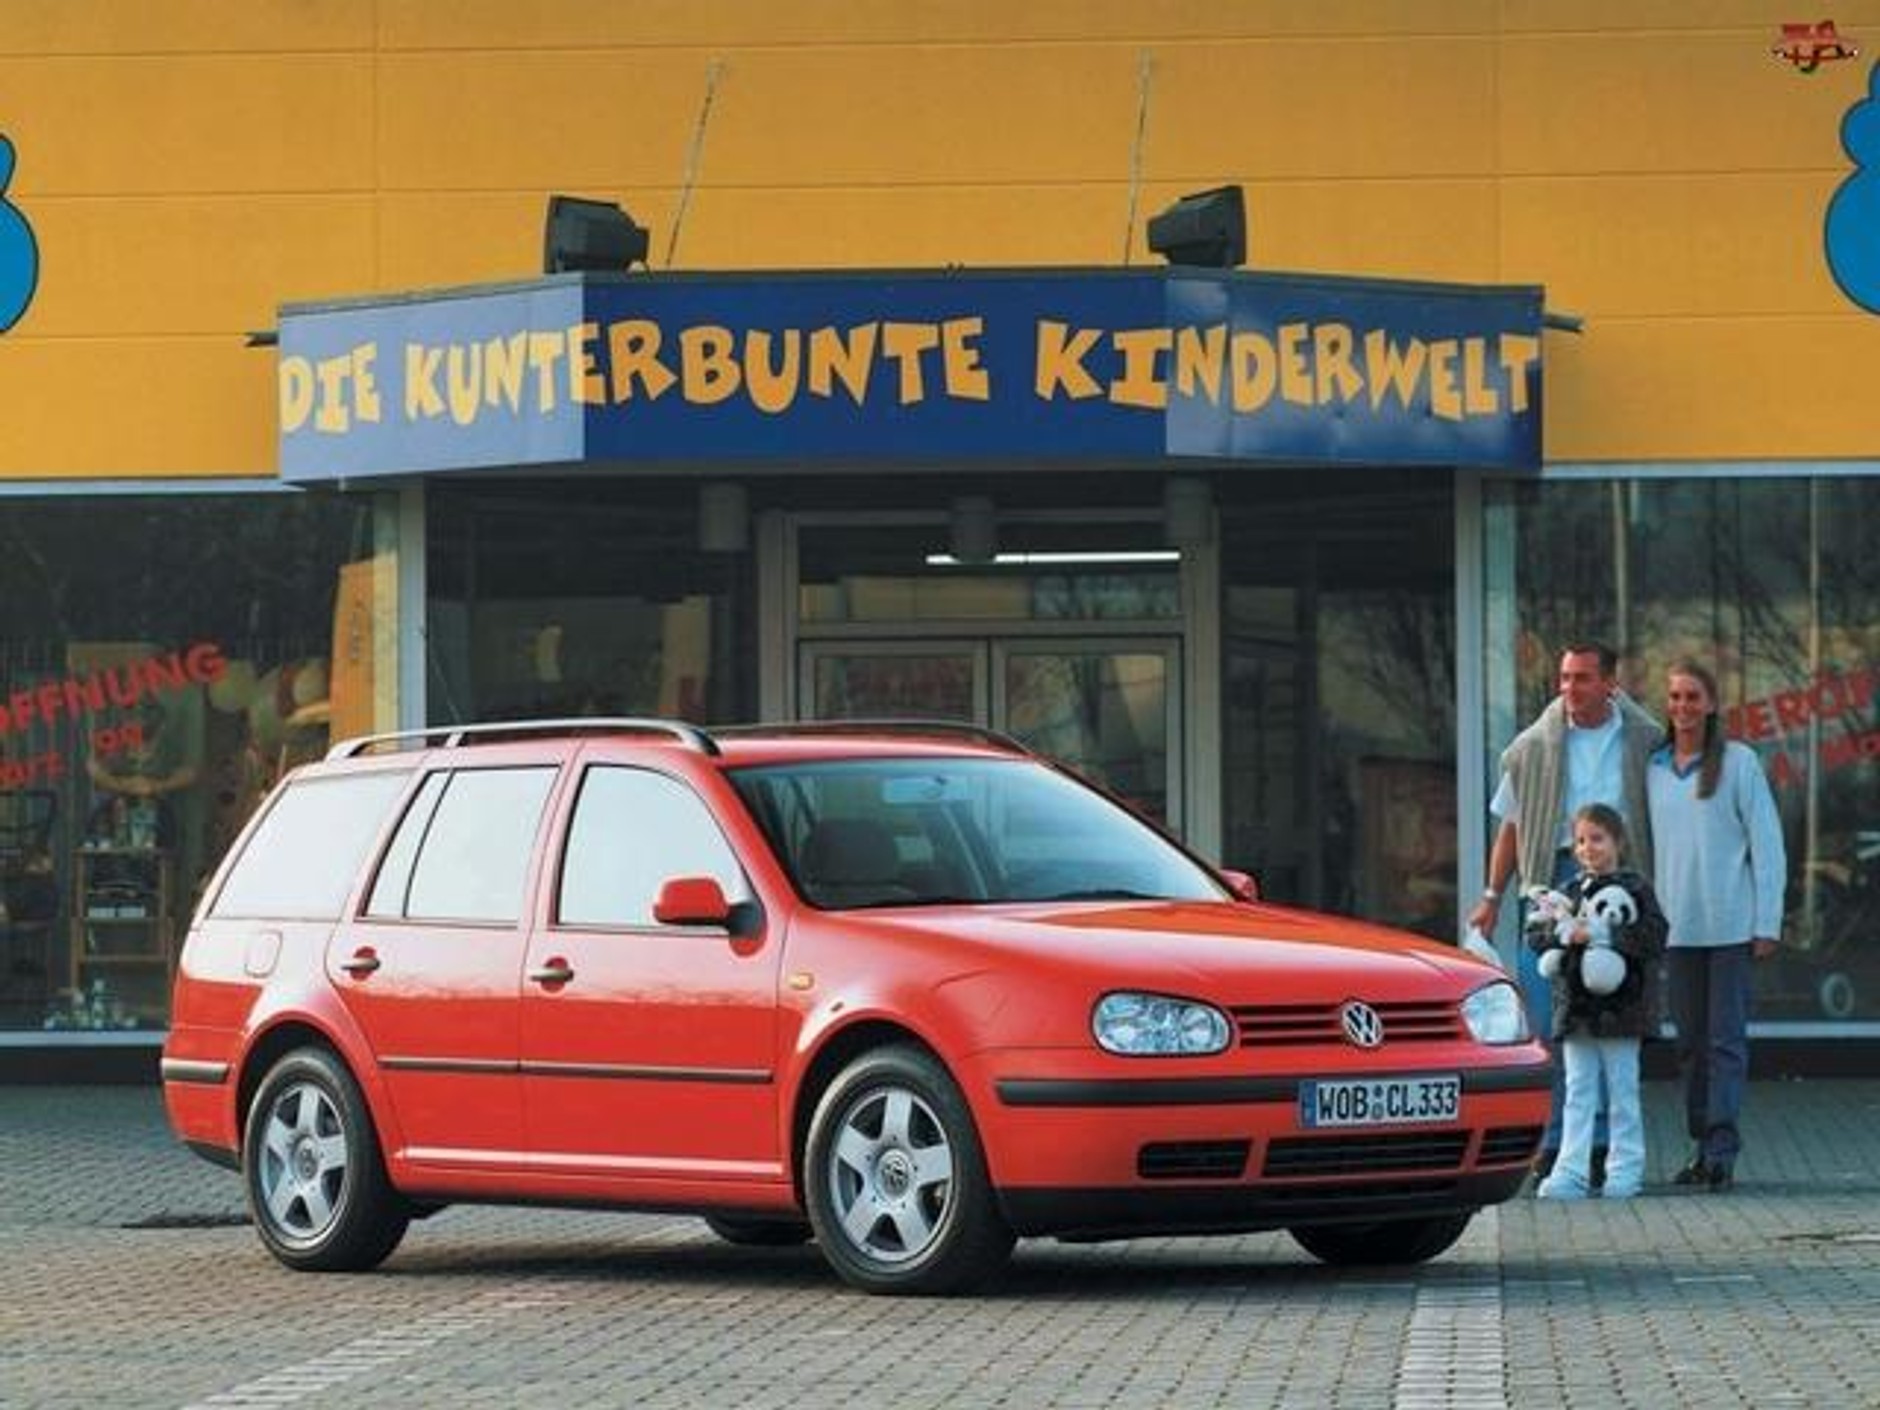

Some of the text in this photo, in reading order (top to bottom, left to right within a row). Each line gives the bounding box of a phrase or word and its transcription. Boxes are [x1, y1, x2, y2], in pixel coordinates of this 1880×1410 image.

[279, 318, 1540, 434] DIE KUNTERBUNTE KINDERWELT
[1319, 1085, 1368, 1120] WOB
